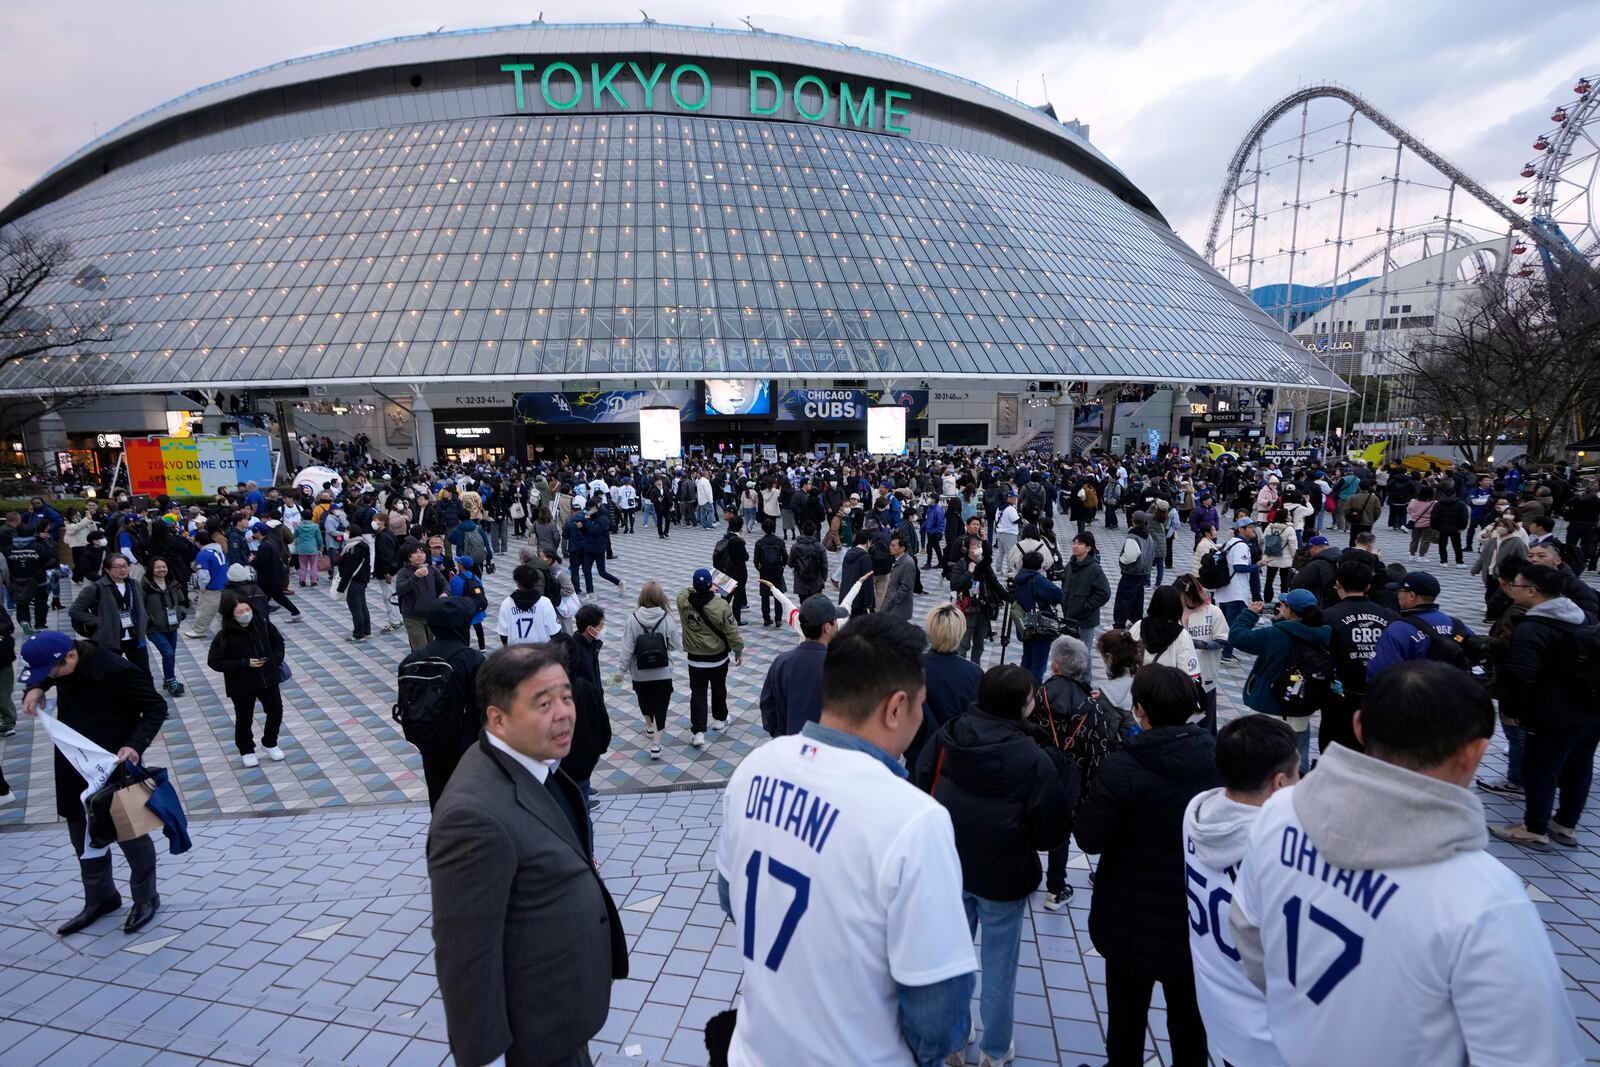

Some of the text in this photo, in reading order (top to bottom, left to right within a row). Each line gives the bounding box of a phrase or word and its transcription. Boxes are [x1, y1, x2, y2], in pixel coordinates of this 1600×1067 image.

[500, 61, 912, 134] TOKYO DOME
[807, 390, 852, 400] CHICAGO
[804, 402, 856, 418] CUBS
[147, 459, 249, 470] TOKYO DOME CITY
[515, 617, 534, 639] 17
[1204, 615, 1213, 624] 17
[1341, 614, 1357, 626] LOS
[1357, 613, 1389, 627] ANGELES
[745, 775, 840, 854] OHTANI
[743, 849, 811, 972] 17
[1282, 895, 1364, 1006] 17
